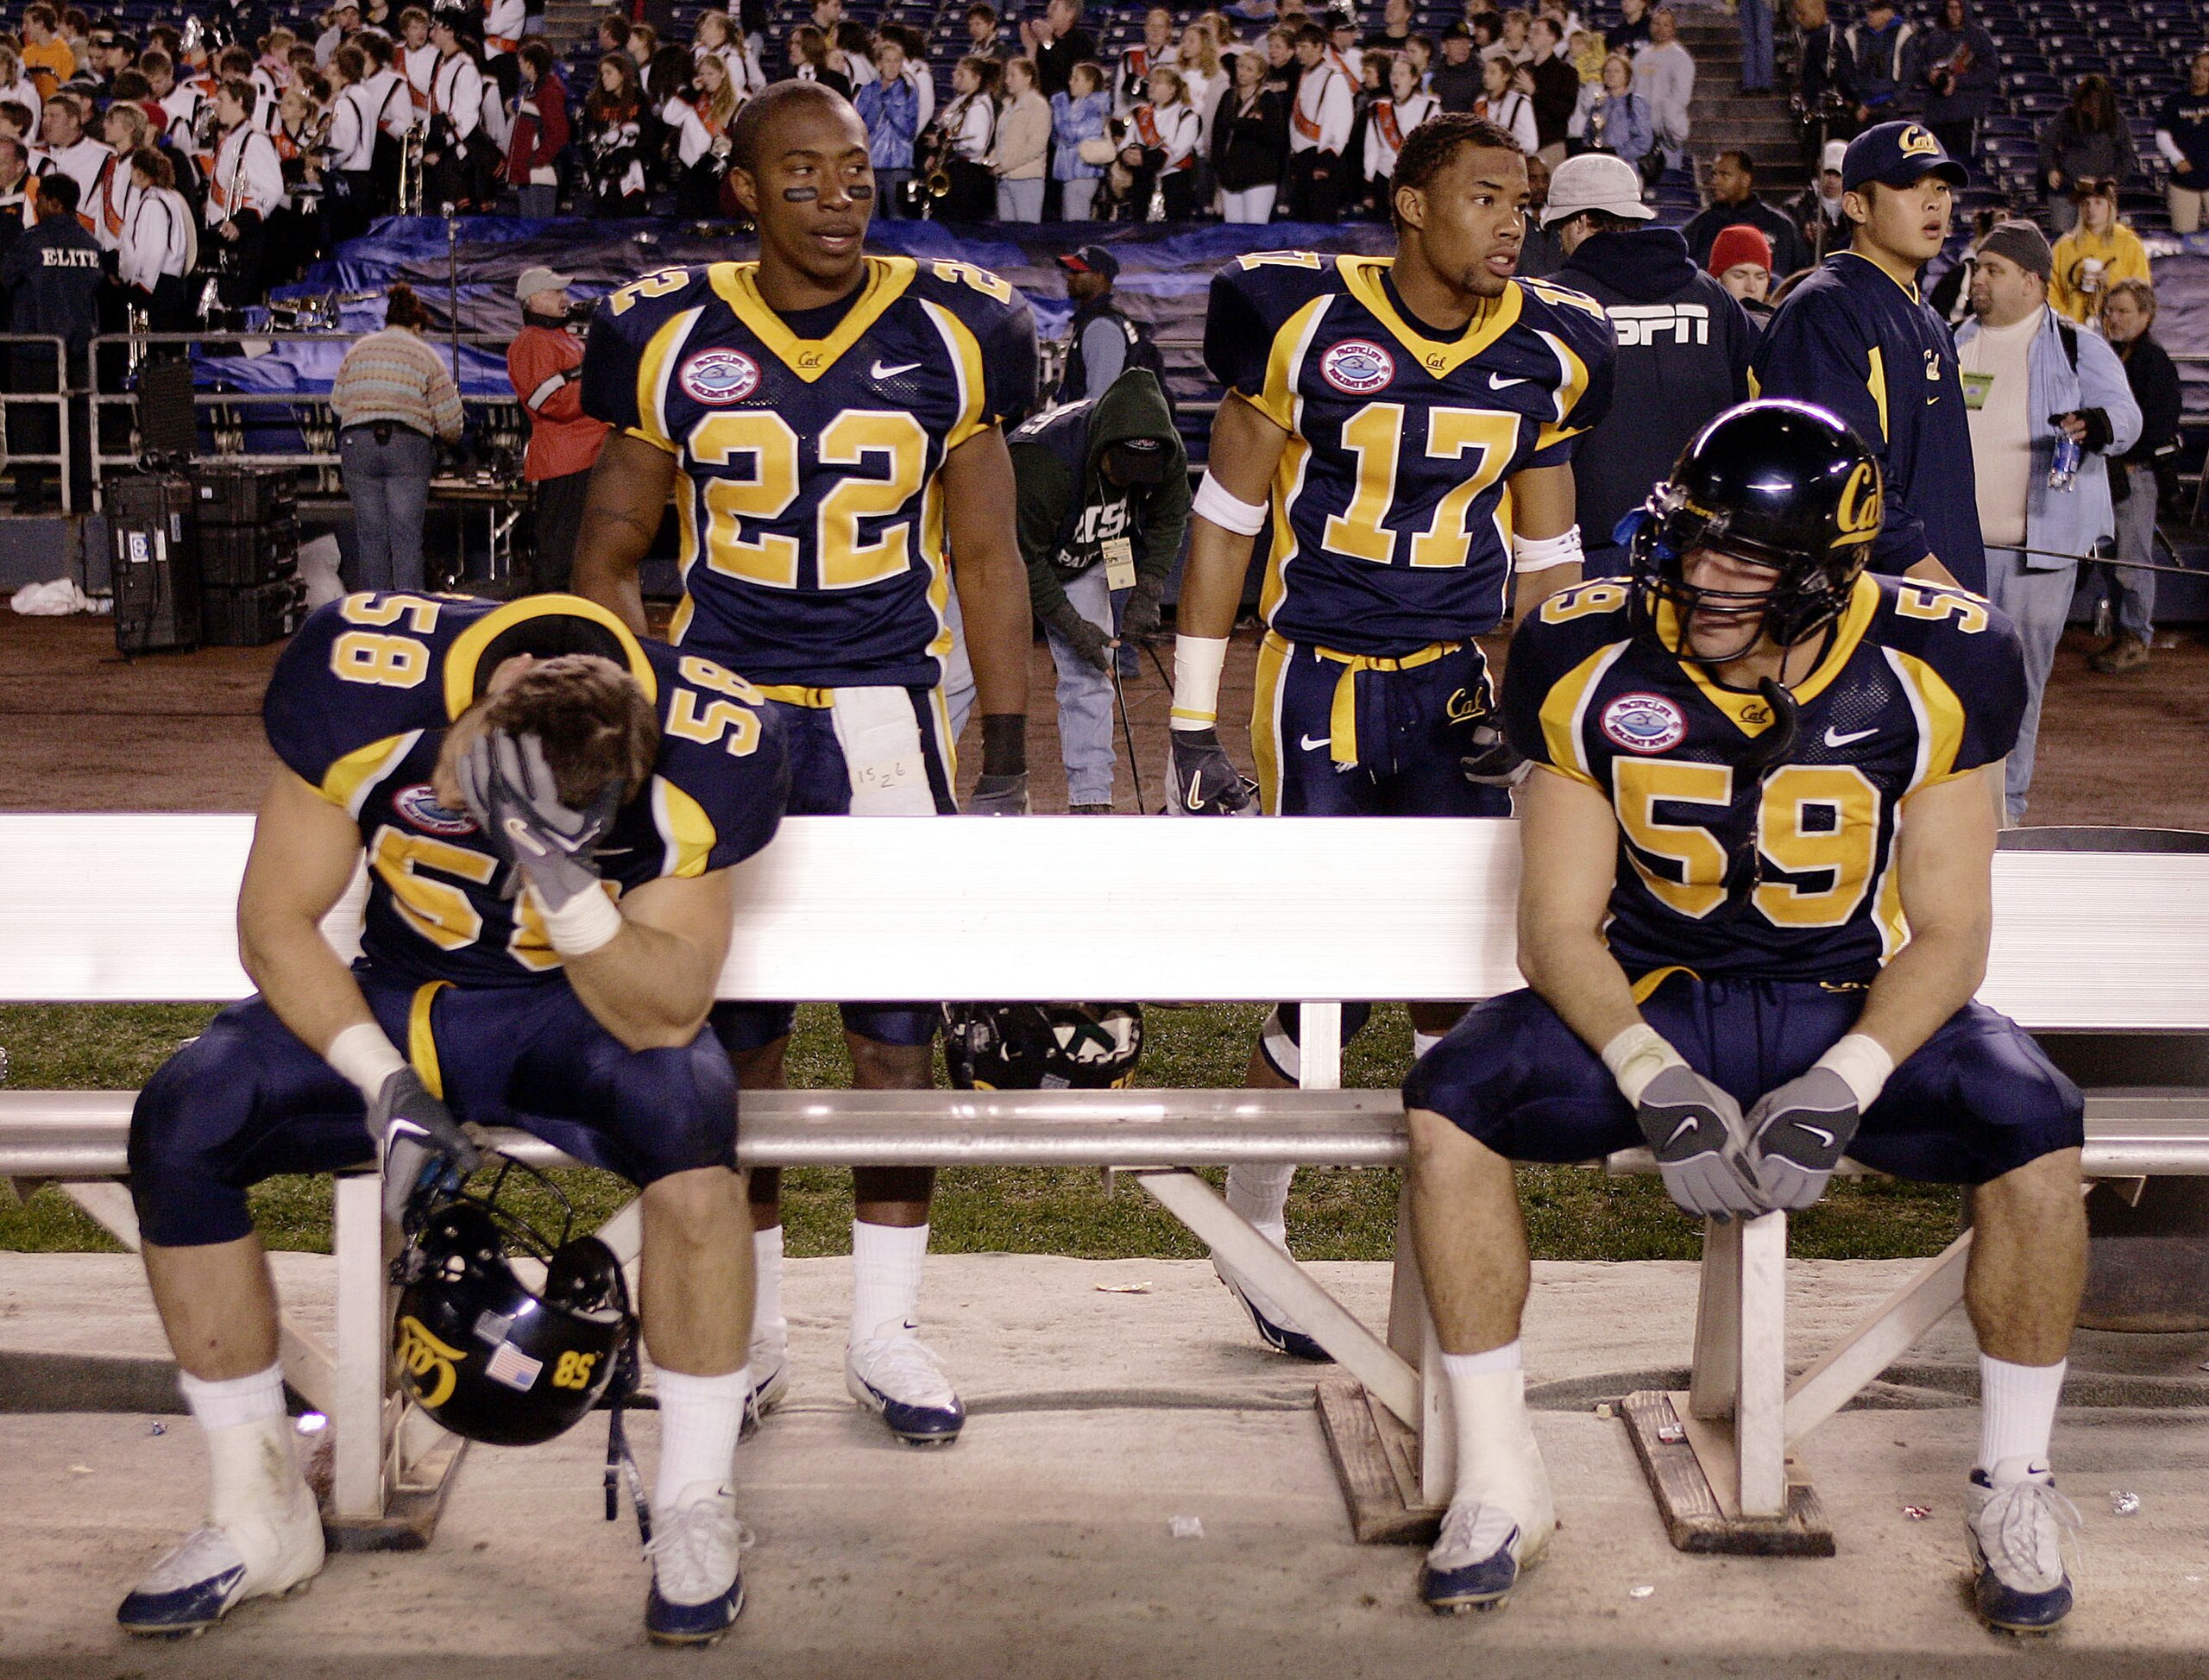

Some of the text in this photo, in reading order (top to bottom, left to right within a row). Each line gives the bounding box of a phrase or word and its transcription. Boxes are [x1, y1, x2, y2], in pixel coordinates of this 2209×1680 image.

[1899, 125, 1939, 159] Cal
[41, 247, 99, 268] ELITE
[1605, 304, 1709, 346] SPN
[796, 350, 823, 369] Cal
[1425, 352, 1446, 371] Cal
[688, 409, 929, 590] 22
[1321, 402, 1521, 568] 17
[330, 592, 443, 689] 58
[664, 654, 765, 757] 58
[1446, 686, 1486, 726] Cal
[1740, 704, 1770, 724] Cal
[1611, 755, 1881, 928] 59
